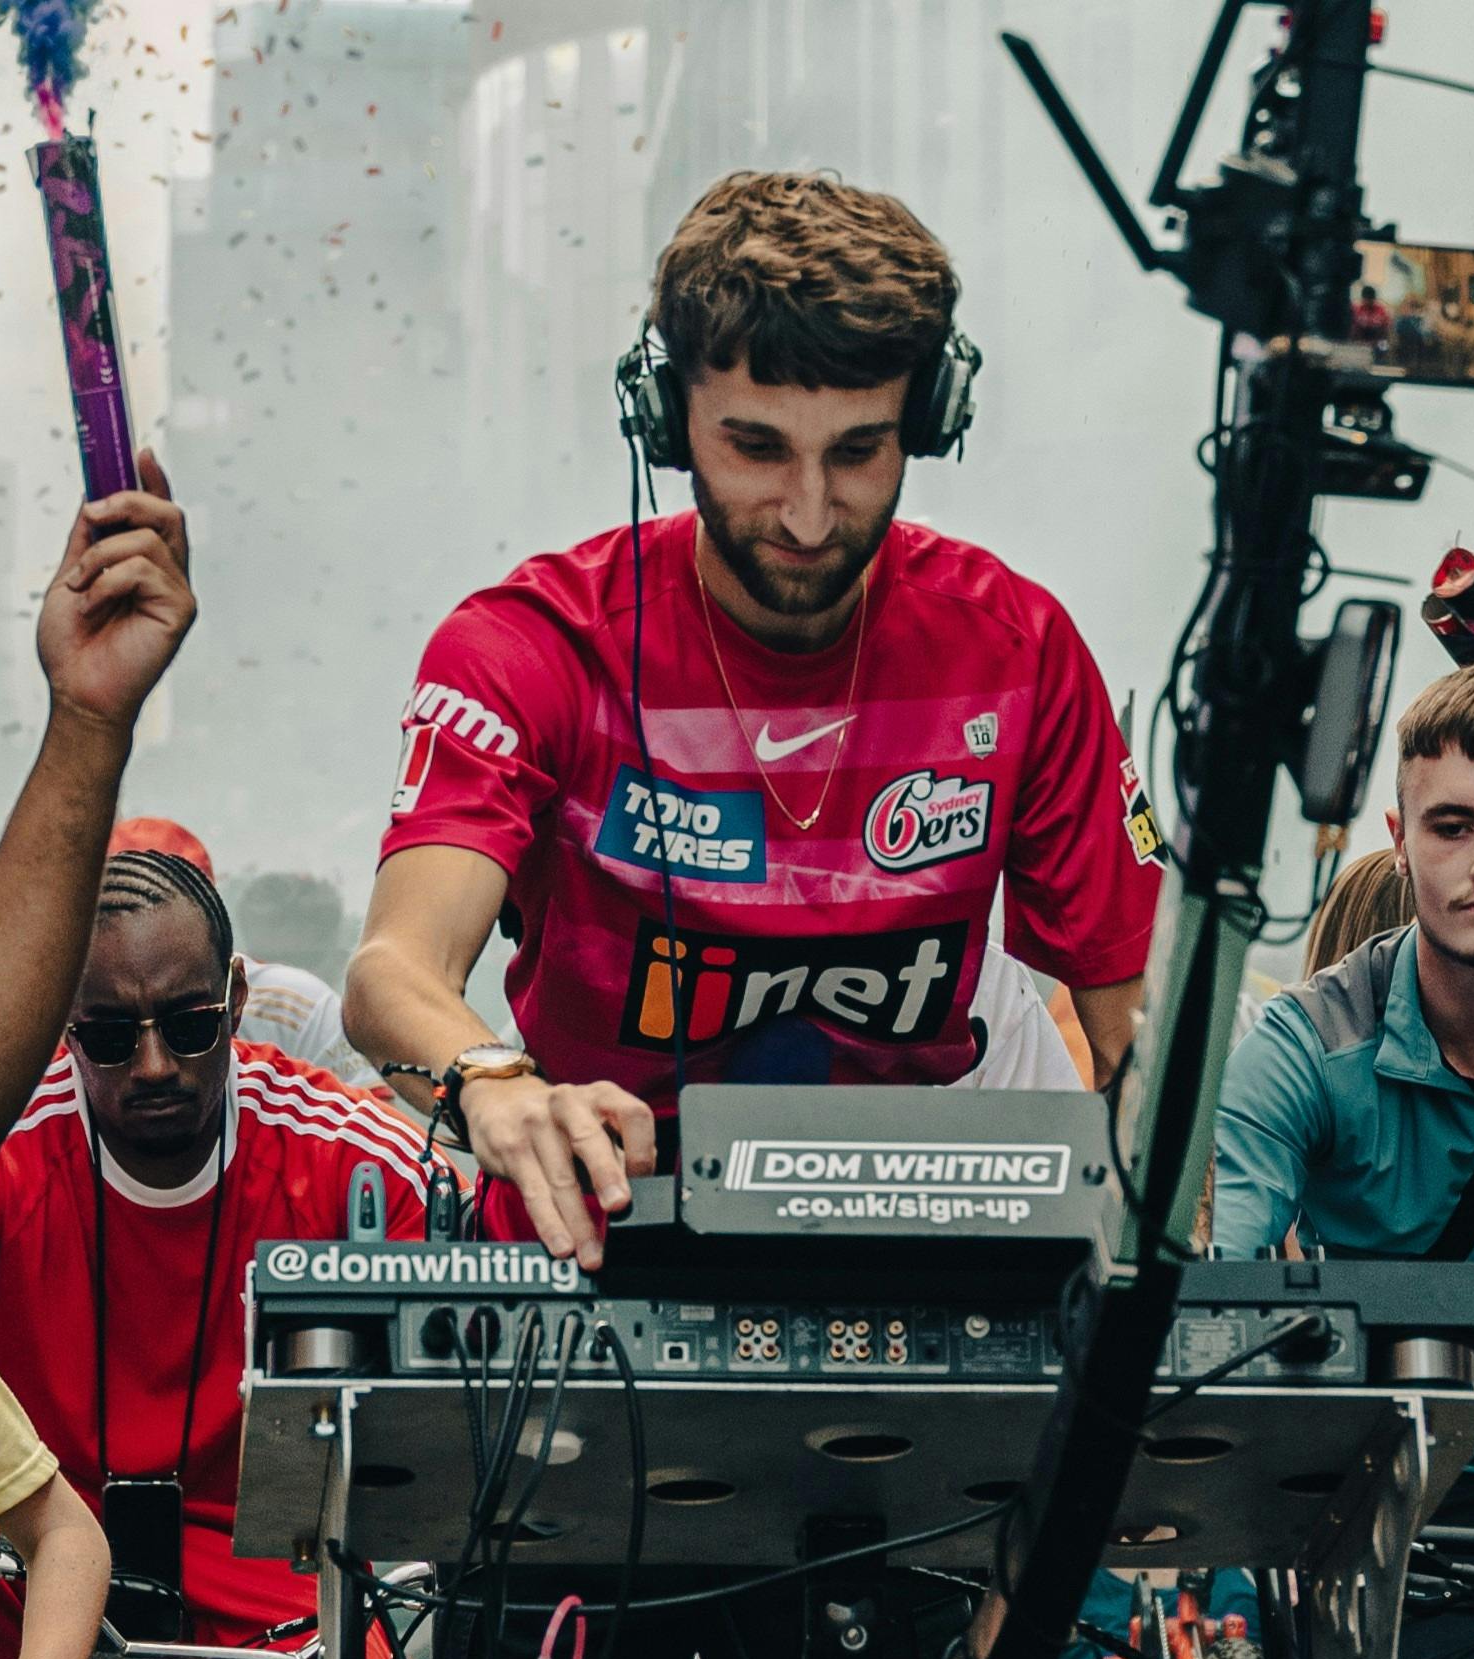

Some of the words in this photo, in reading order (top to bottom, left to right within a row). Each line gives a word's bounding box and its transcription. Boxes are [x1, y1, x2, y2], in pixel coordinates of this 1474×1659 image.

[974, 732, 990, 746] 10
[624, 781, 721, 836] TOYO
[870, 778, 981, 860] 6ers
[927, 790, 982, 816] Sydney
[639, 936, 948, 1041] iinet
[763, 1152, 862, 1180] DOM
[872, 1154, 1053, 1183] WHITING
[776, 1193, 1030, 1225] .co.uk/sign-up
[267, 1244, 579, 1292] @domwhiting
